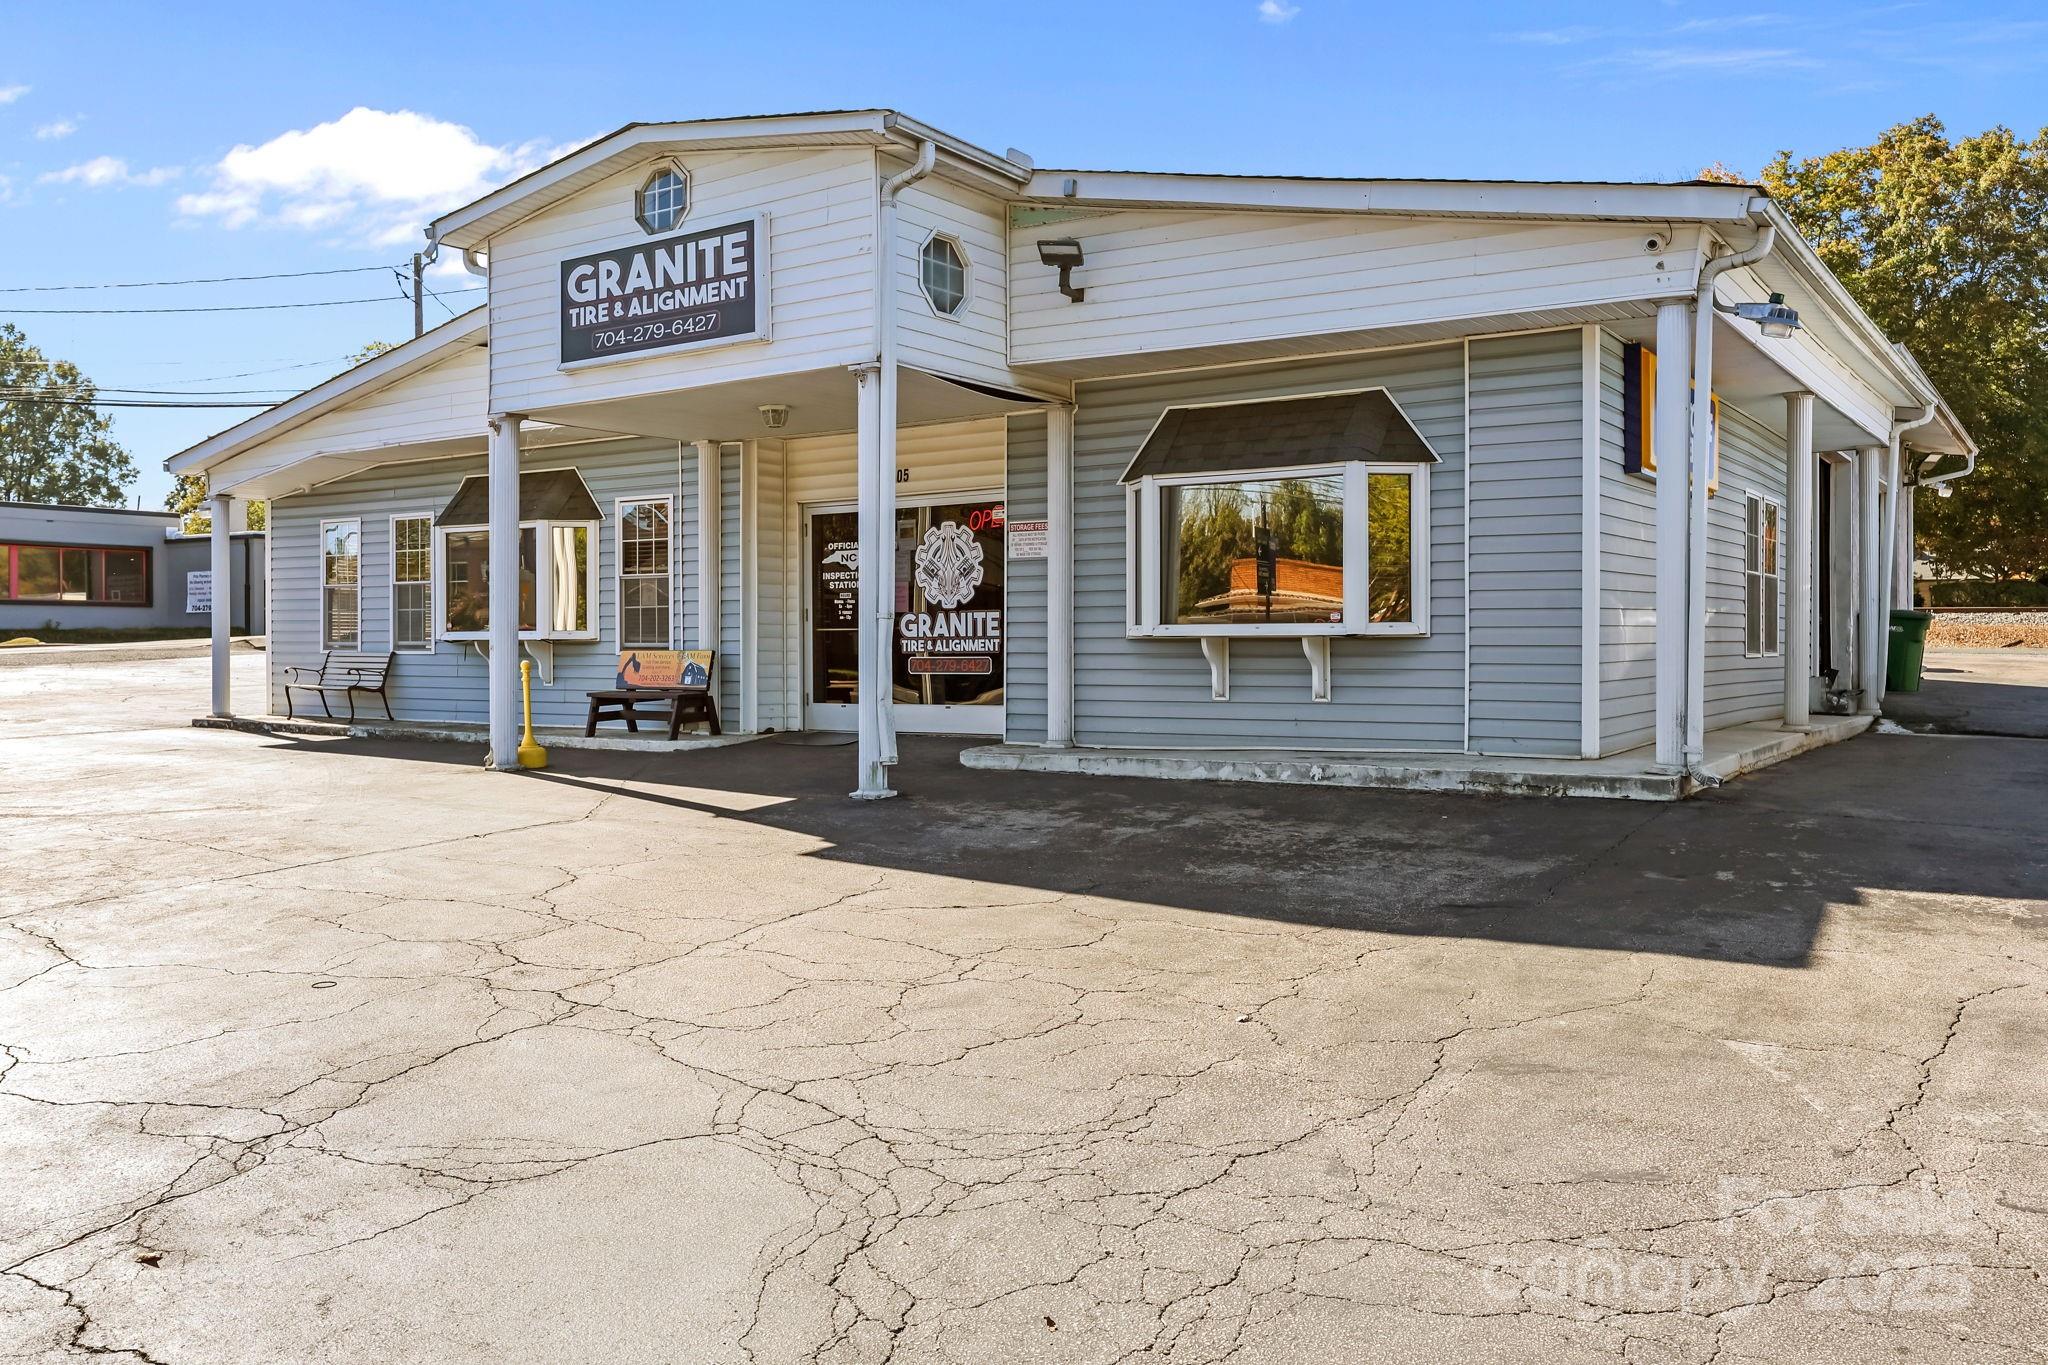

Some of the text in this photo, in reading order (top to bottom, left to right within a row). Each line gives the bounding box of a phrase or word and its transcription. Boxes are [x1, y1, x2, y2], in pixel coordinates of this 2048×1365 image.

[566, 230, 748, 303] GRANITE
[569, 276, 748, 327] TIRE & ALIGNMENT
[595, 314, 717, 348] 704-279-6427
[897, 469, 909, 483] 05
[1034, 522, 1048, 530] FEES
[828, 541, 859, 550] OFFICIA
[841, 553, 857, 563] NC
[822, 571, 859, 580] INSPECTI
[900, 611, 1000, 638] GRANITE
[901, 639, 1000, 652] TIRE & ALIGNMENT
[911, 659, 990, 672] 704-279-6427
